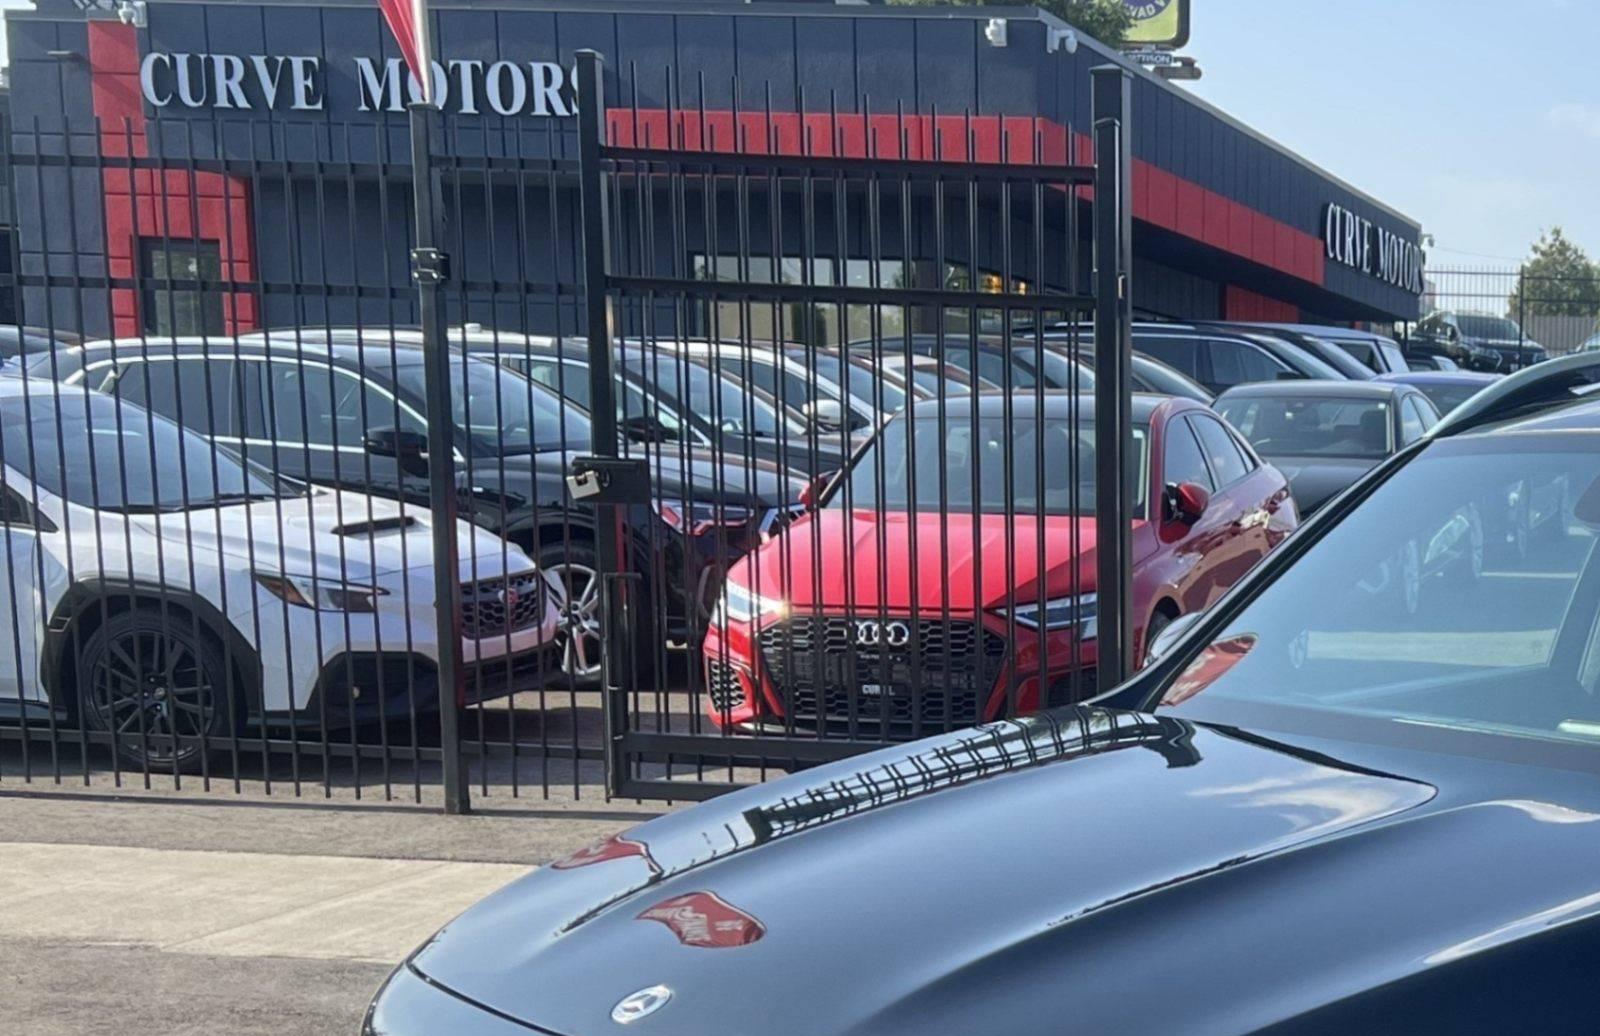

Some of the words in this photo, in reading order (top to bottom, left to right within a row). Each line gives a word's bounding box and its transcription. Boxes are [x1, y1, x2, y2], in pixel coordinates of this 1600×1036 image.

[140, 52, 324, 110] CURVE
[354, 56, 578, 117] MOTOR
[1326, 202, 1372, 273] CURVE
